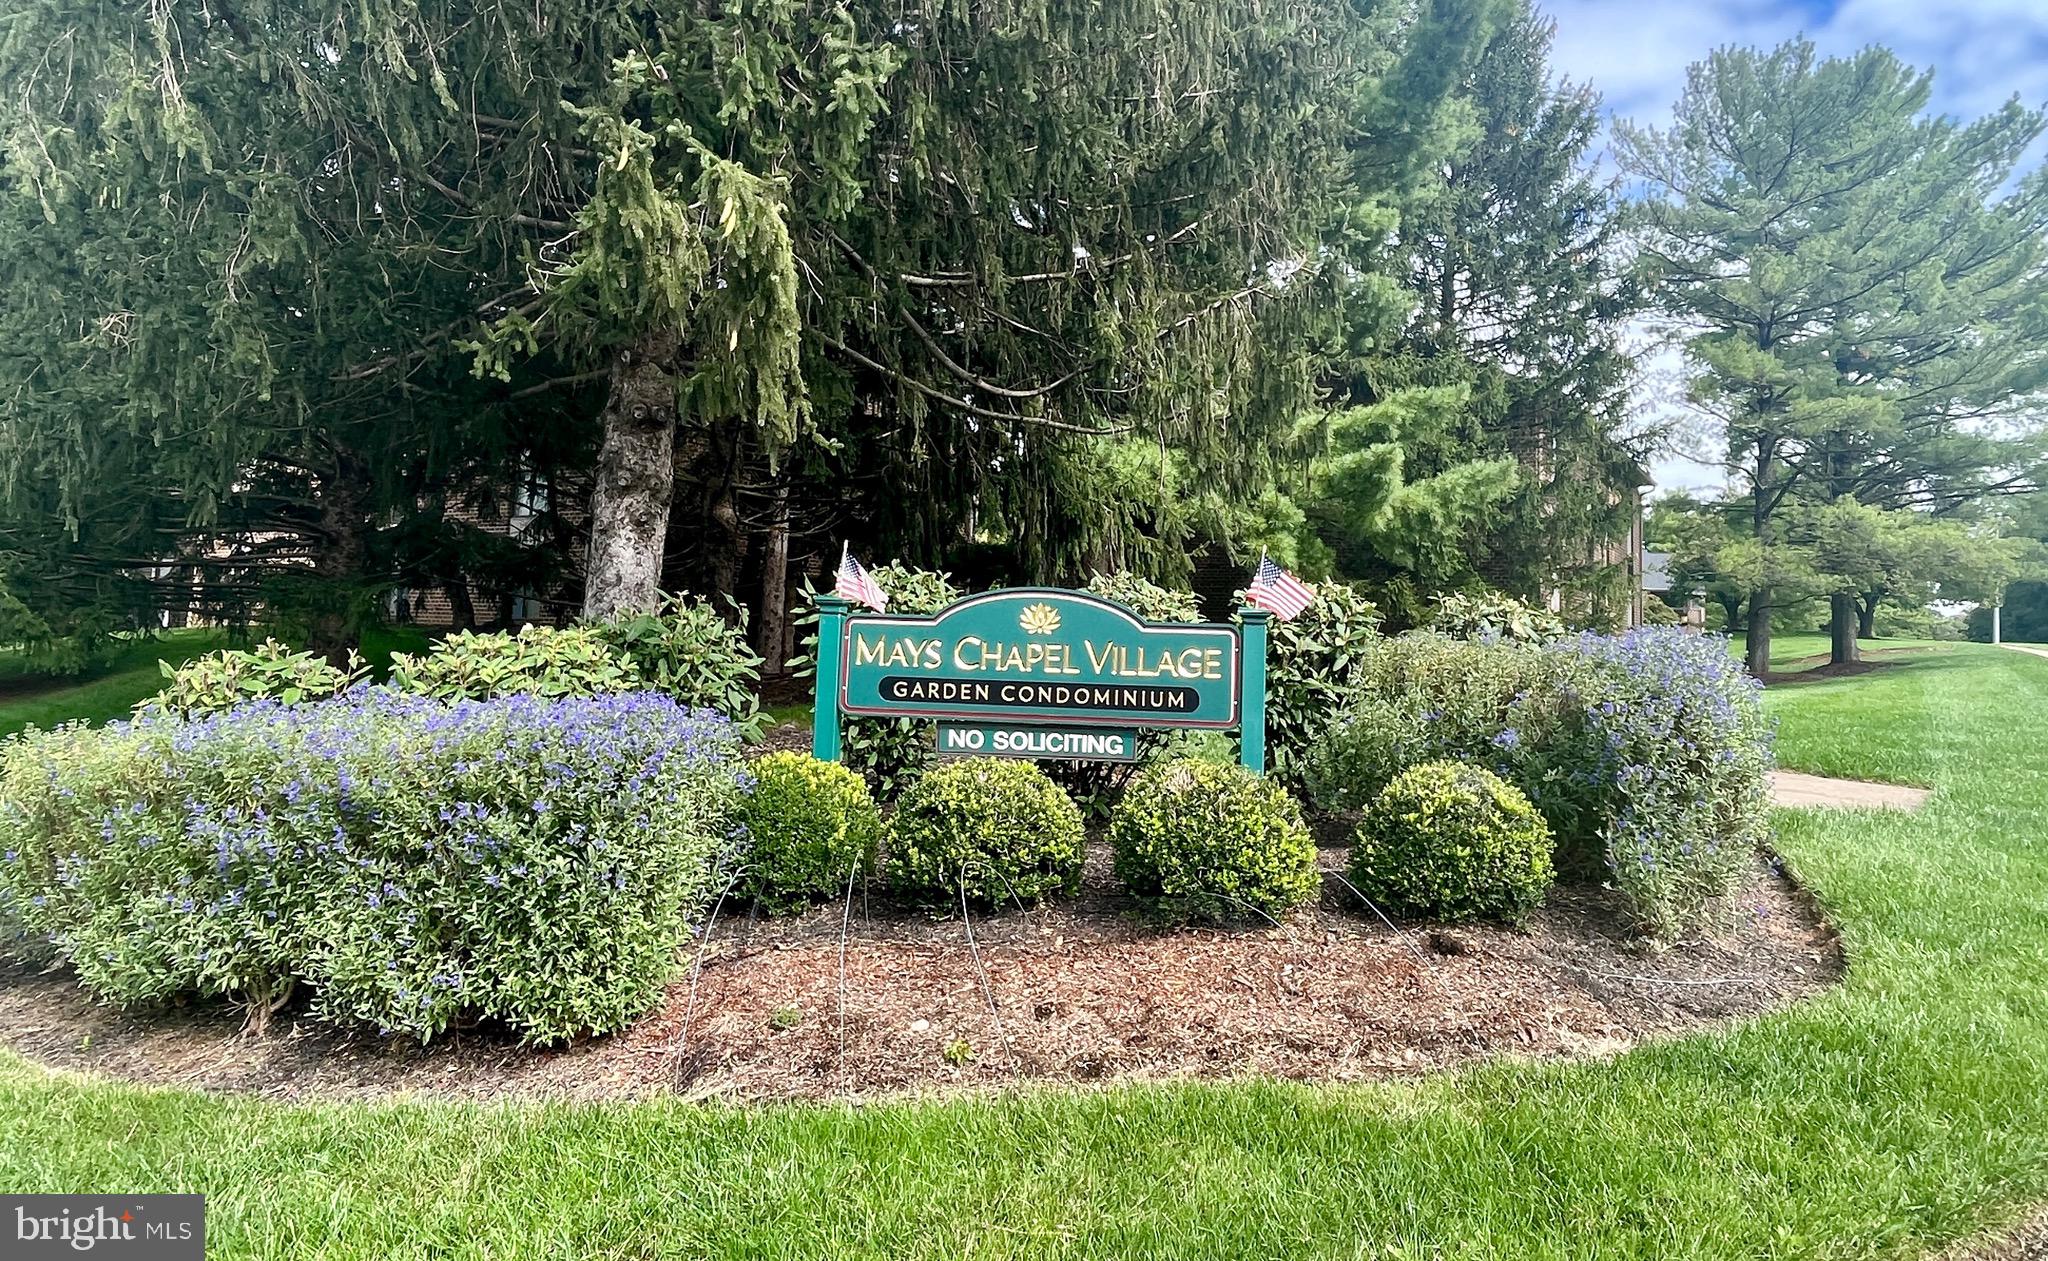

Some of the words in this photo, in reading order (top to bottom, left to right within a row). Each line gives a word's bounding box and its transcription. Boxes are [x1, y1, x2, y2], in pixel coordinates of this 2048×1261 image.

[855, 632, 942, 670] MAYS
[953, 635, 1081, 675] CHAPEL
[1084, 640, 1223, 680] VILLAGE
[893, 681, 990, 701] GARDEN
[1001, 685, 1185, 708] CONDOMINIUM
[948, 729, 985, 750] NO
[993, 731, 1124, 755] SOLICITING
